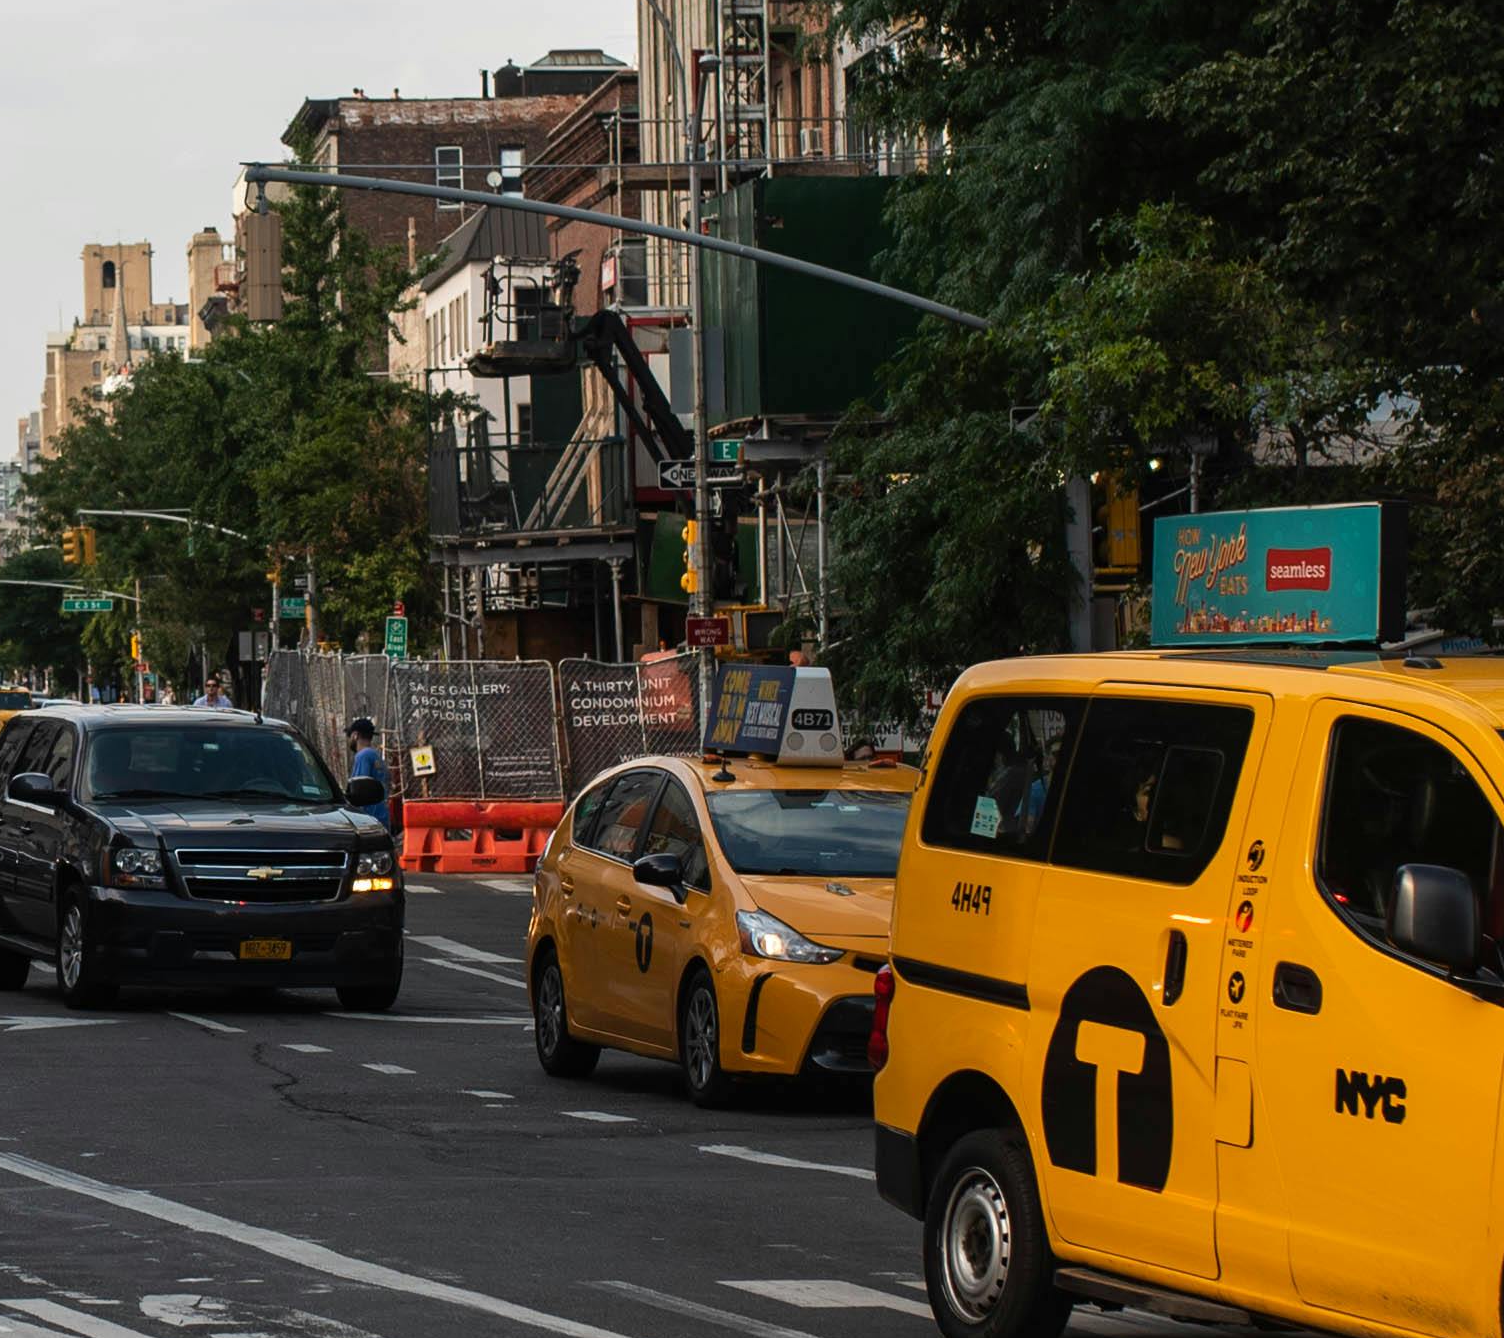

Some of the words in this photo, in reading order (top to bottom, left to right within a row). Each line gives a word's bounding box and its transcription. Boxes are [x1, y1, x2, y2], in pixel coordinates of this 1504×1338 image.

[670, 466, 695, 481] ONE
[1177, 527, 1201, 546] HOW
[1270, 561, 1326, 580] seamless
[1219, 576, 1249, 596] EATS
[694, 628, 722, 637] WRONG
[699, 636, 717, 644] WAY
[449, 683, 511, 695] GALLERY:
[570, 682, 582, 692] A
[584, 680, 634, 692] THIRTY
[641, 677, 672, 691] UNIT
[570, 694, 676, 710] CONDOMINIUM
[432, 709, 472, 722] FLOOR
[571, 712, 678, 728] DEVELOPMENT
[794, 711, 833, 726] 4B71
[951, 881, 993, 916] 4H49
[1334, 1067, 1408, 1126] NYC
